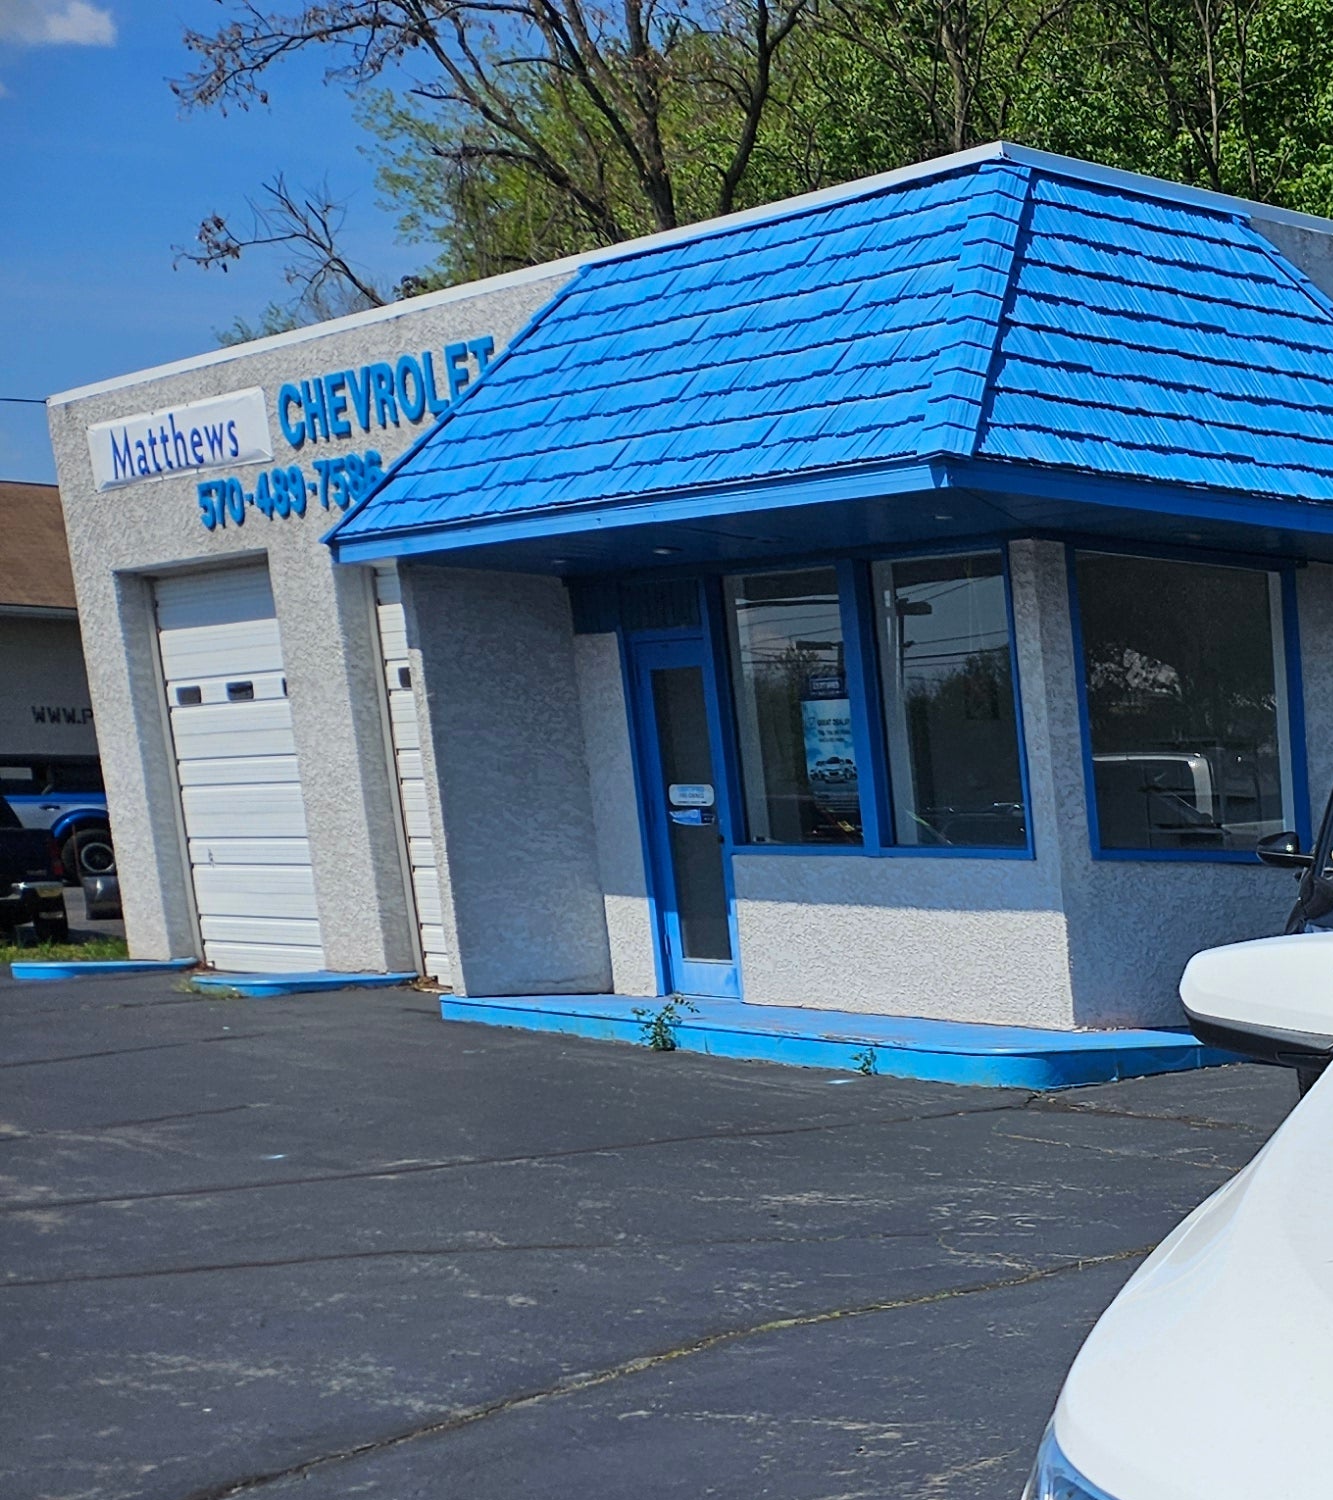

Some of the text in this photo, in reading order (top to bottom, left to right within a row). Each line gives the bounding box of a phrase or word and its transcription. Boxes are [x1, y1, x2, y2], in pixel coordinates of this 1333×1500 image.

[278, 335, 494, 449] CHEVROLET
[108, 413, 240, 481] Matthews
[198, 449, 386, 532] 570-489-7586
